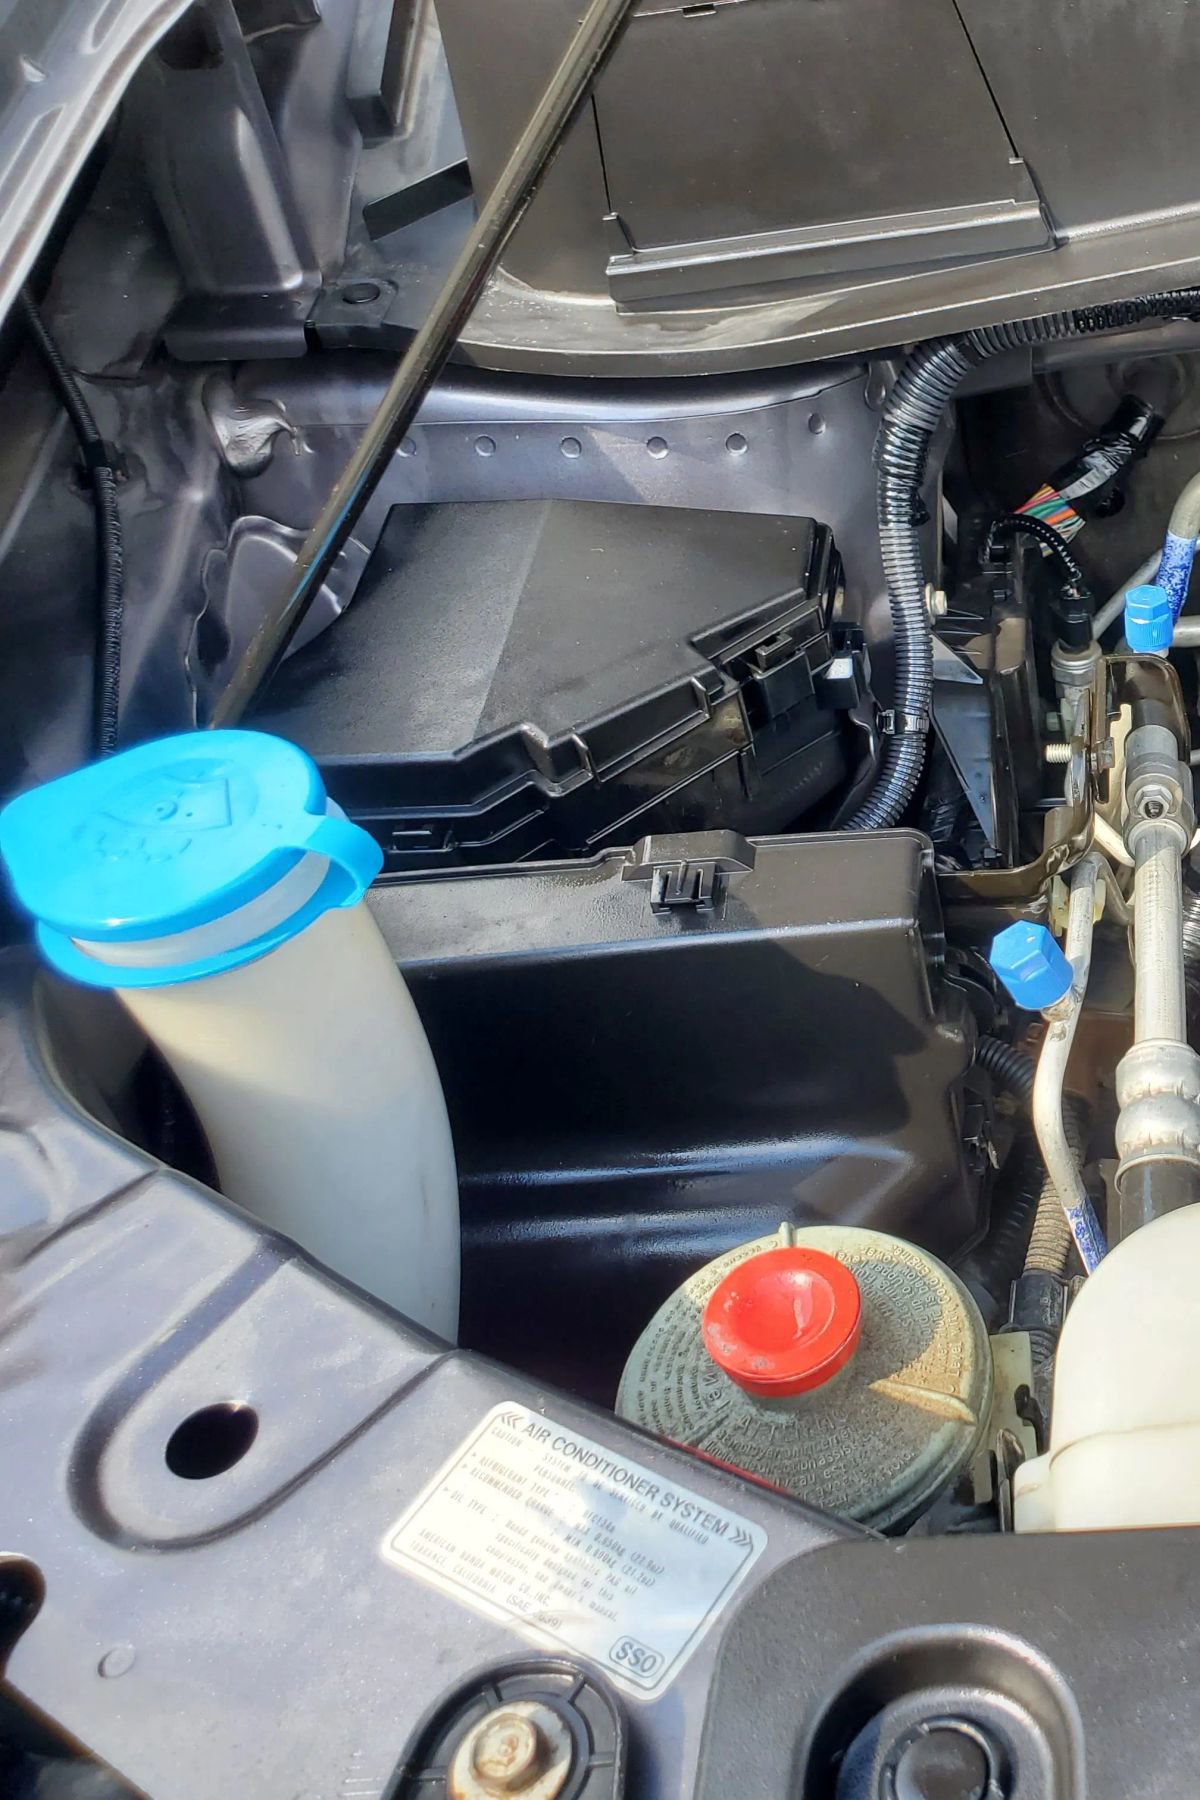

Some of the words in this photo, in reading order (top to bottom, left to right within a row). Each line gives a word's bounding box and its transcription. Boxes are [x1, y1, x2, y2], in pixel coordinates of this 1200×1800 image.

[870, 1260, 906, 1288] Upper
[899, 1265, 930, 1295] below
[880, 1280, 914, 1328] Steering
[902, 1285, 915, 1299] to
[927, 1276, 952, 1304] Cold
[911, 1299, 926, 1313] up
[520, 1421, 552, 1444] AIR
[547, 1434, 663, 1500] CONDITIONER
[657, 1491, 731, 1536] SYSTEM
